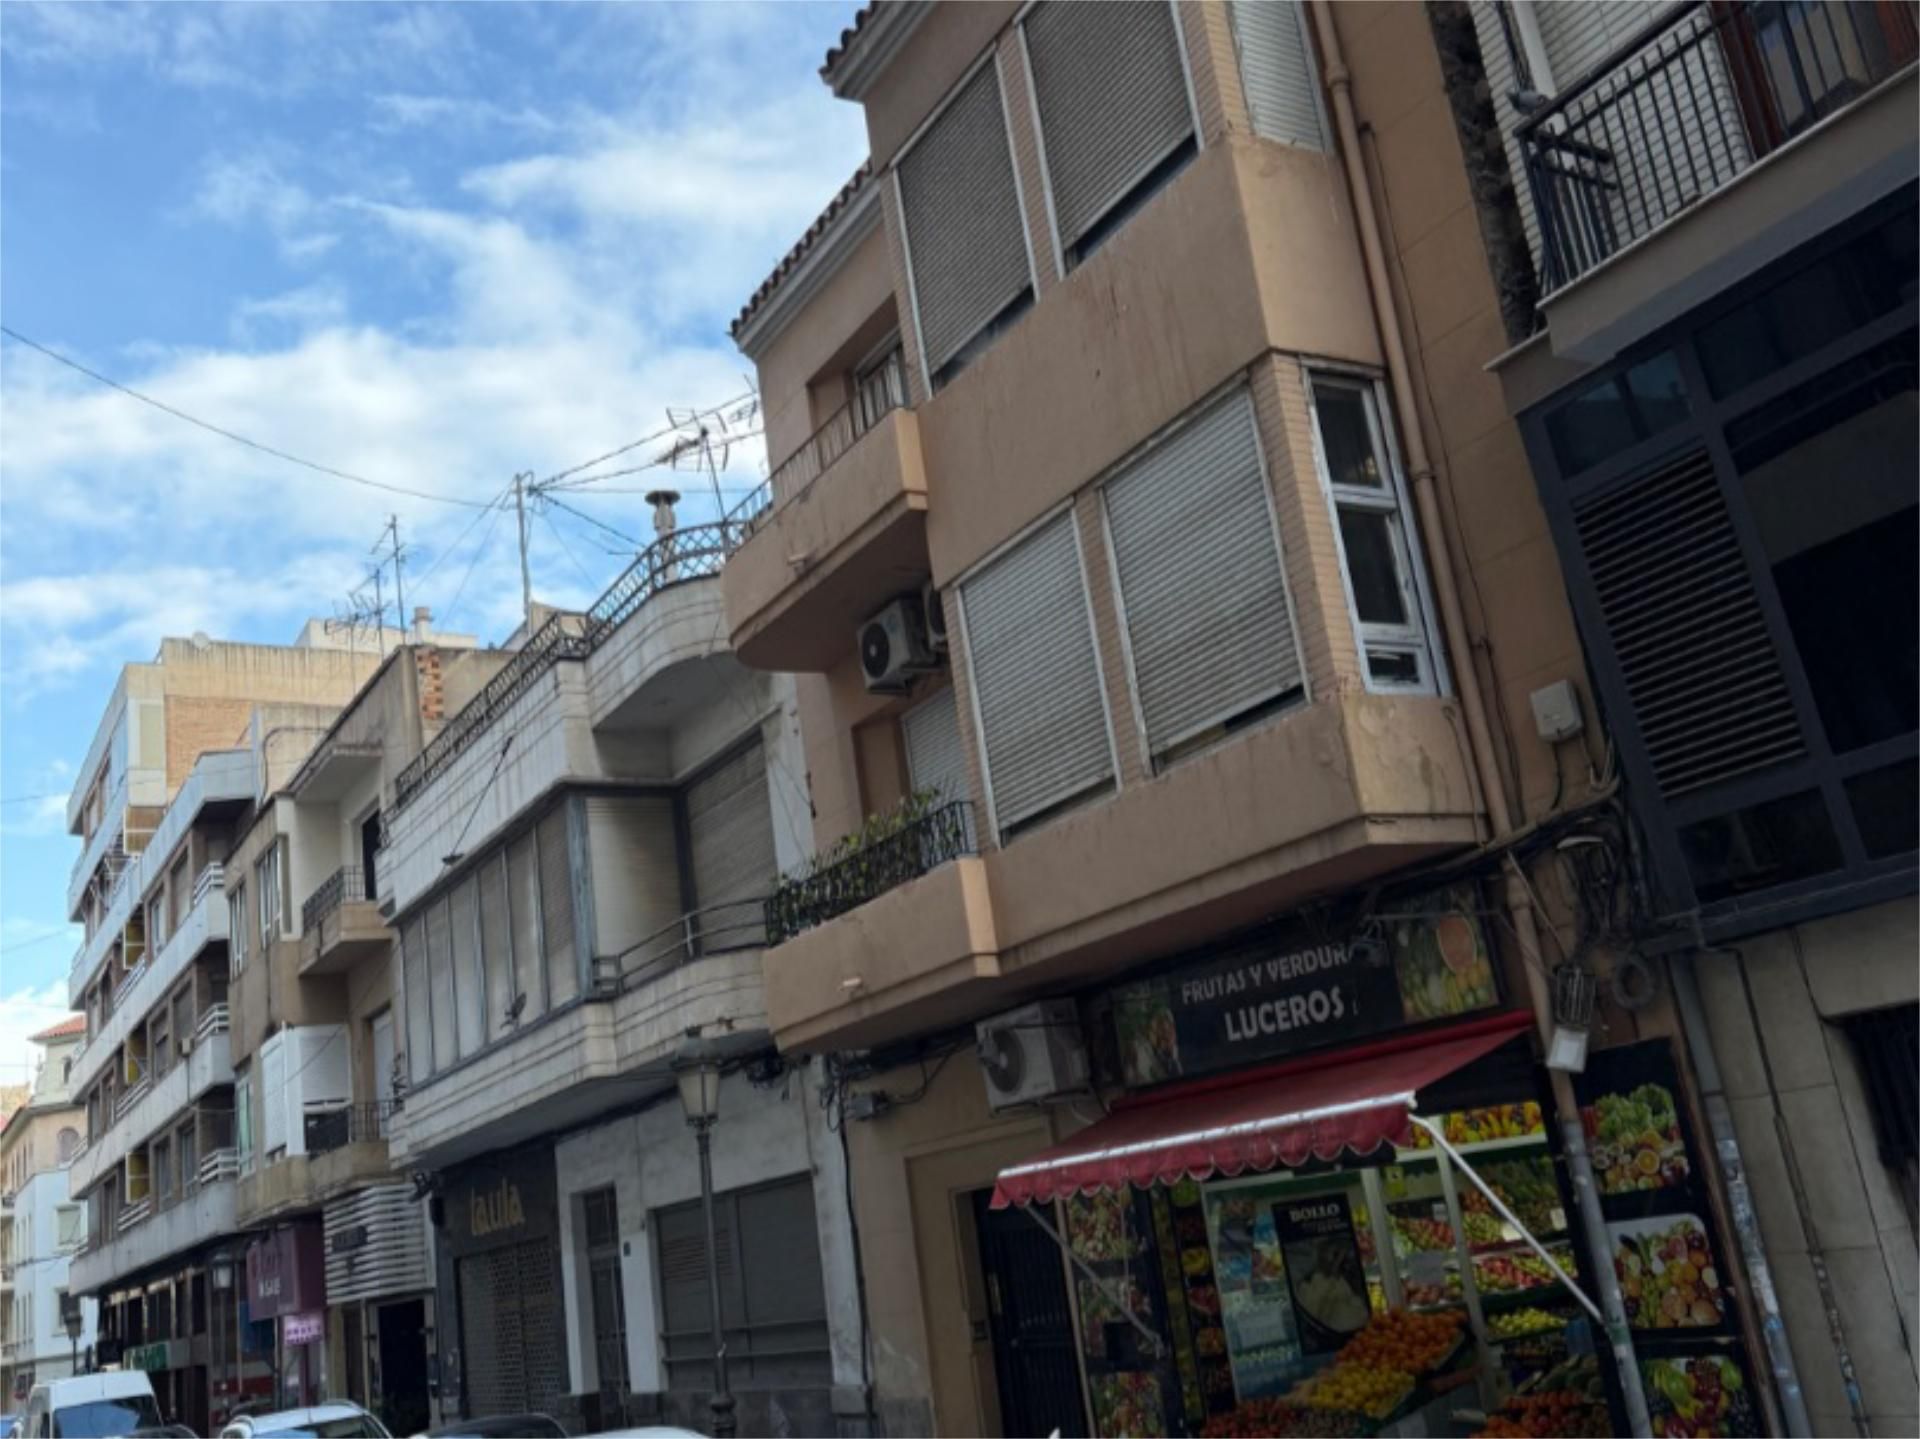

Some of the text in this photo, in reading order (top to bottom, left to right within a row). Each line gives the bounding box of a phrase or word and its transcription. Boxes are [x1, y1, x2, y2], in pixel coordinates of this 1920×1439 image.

[1181, 968, 1247, 1005] FRUTAS
[1248, 964, 1262, 987] Y
[1224, 985, 1345, 1042] LUCEROS
[1289, 1202, 1341, 1223] BOLLO
